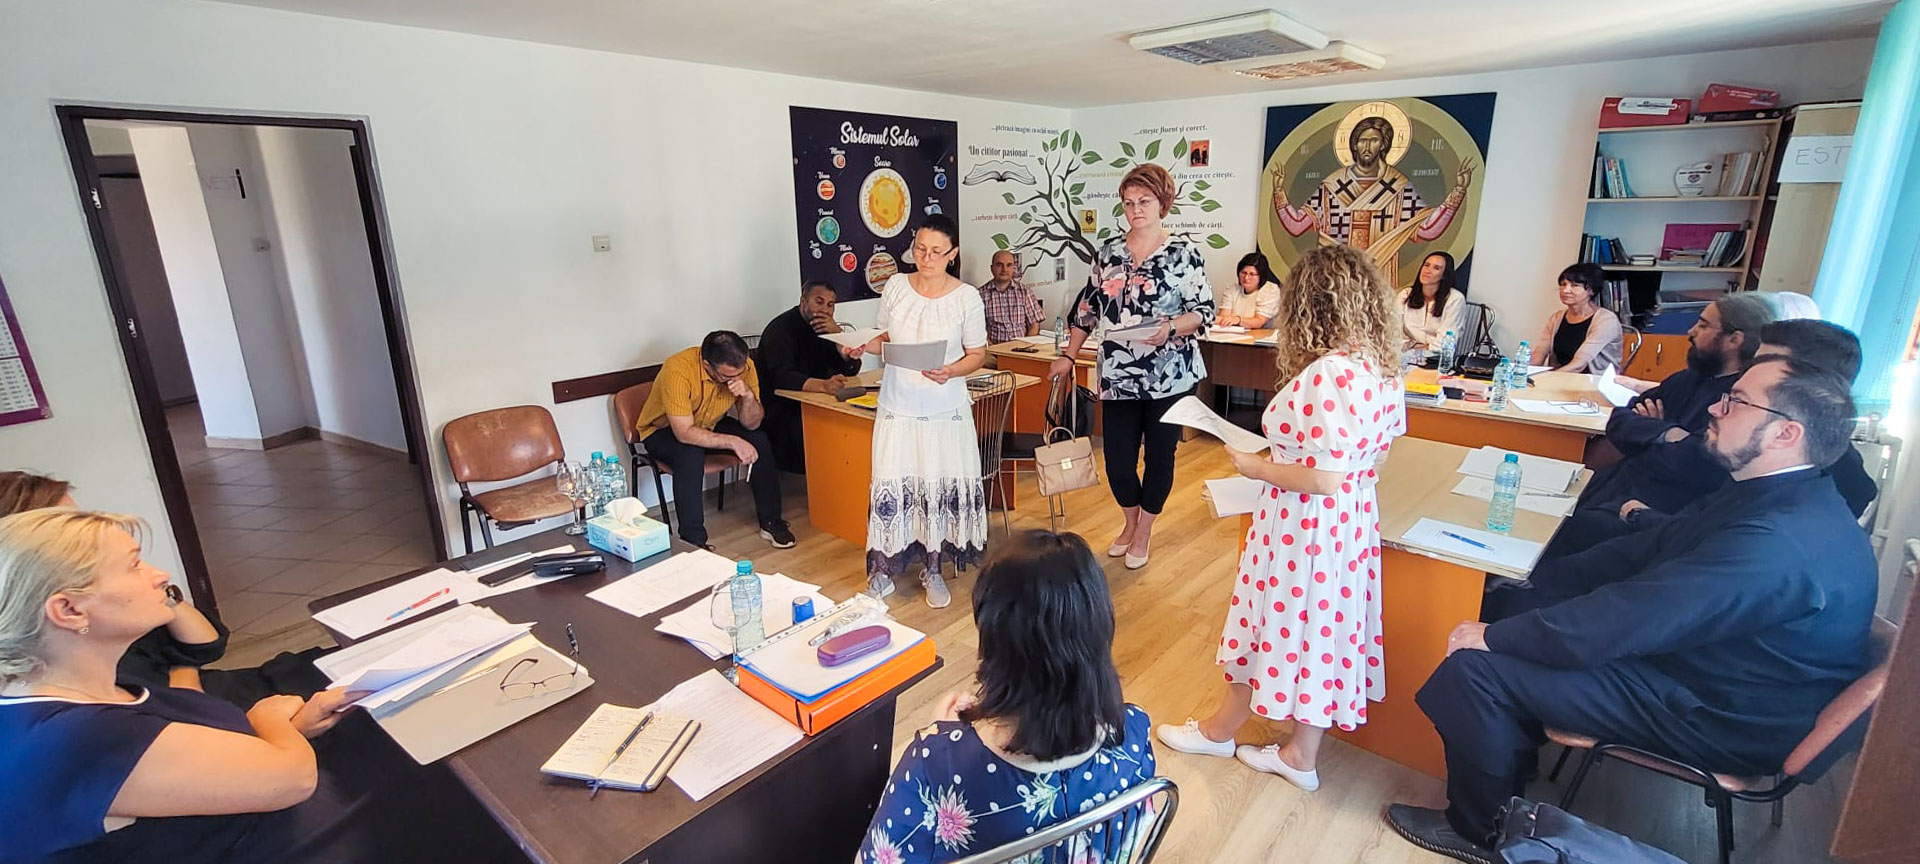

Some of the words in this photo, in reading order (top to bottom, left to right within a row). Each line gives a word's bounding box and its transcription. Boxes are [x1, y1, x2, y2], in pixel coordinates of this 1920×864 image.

[840, 121, 889, 145] Sistemul
[889, 125, 920, 147] Solar
[1002, 147, 1027, 159] pasionat
[1795, 145, 1853, 166] EST
